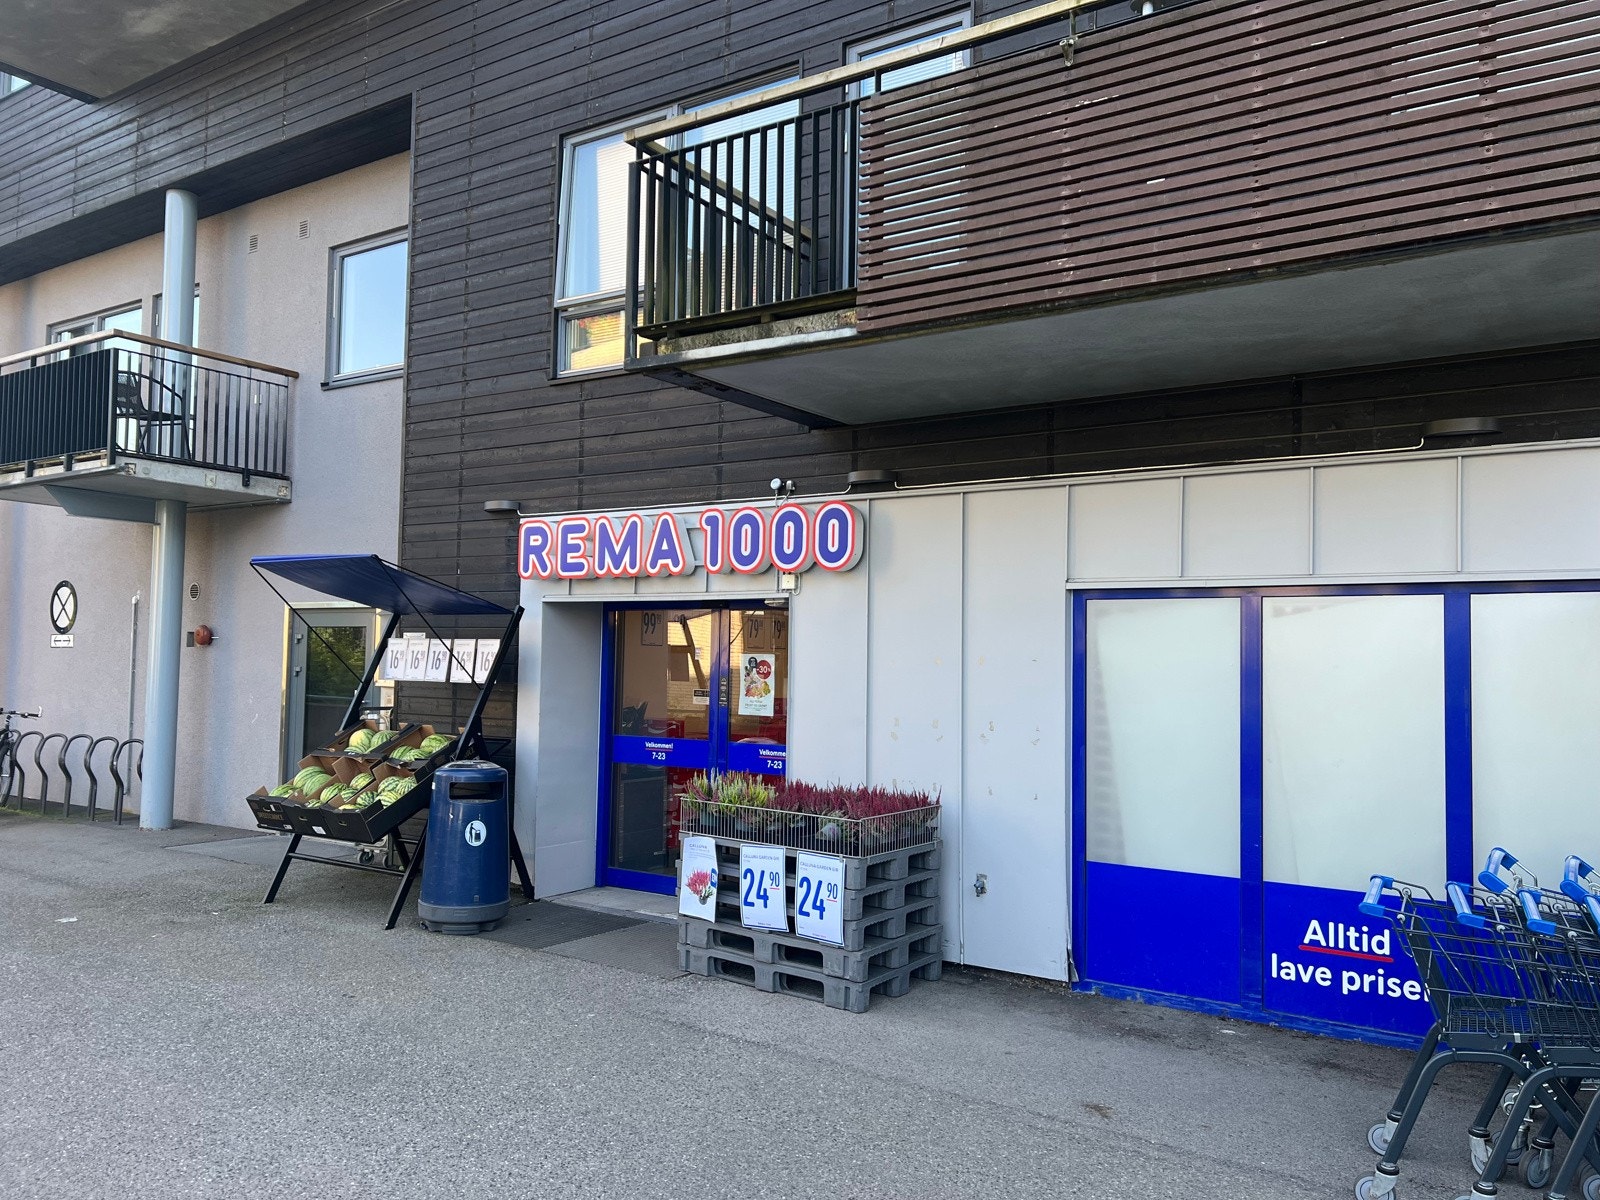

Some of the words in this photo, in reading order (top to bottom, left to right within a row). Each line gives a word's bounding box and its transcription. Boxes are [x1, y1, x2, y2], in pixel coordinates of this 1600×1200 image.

[518, 511, 686, 580] REMA
[699, 502, 856, 575] 1000
[390, 650, 399, 669] 16
[410, 650, 420, 670] 16
[431, 650, 442, 670] 16
[480, 651, 490, 672] 16
[645, 741, 674, 750] Velkommen!
[758, 748, 787, 757] Velkomme
[651, 752, 666, 760] 7-23
[767, 760, 783, 769] 7-23
[743, 868, 769, 909] 24
[769, 871, 780, 888] 90
[798, 876, 826, 920] 24
[827, 882, 838, 900] 90
[1303, 919, 1391, 956] Alltid
[1271, 953, 1332, 987] lave
